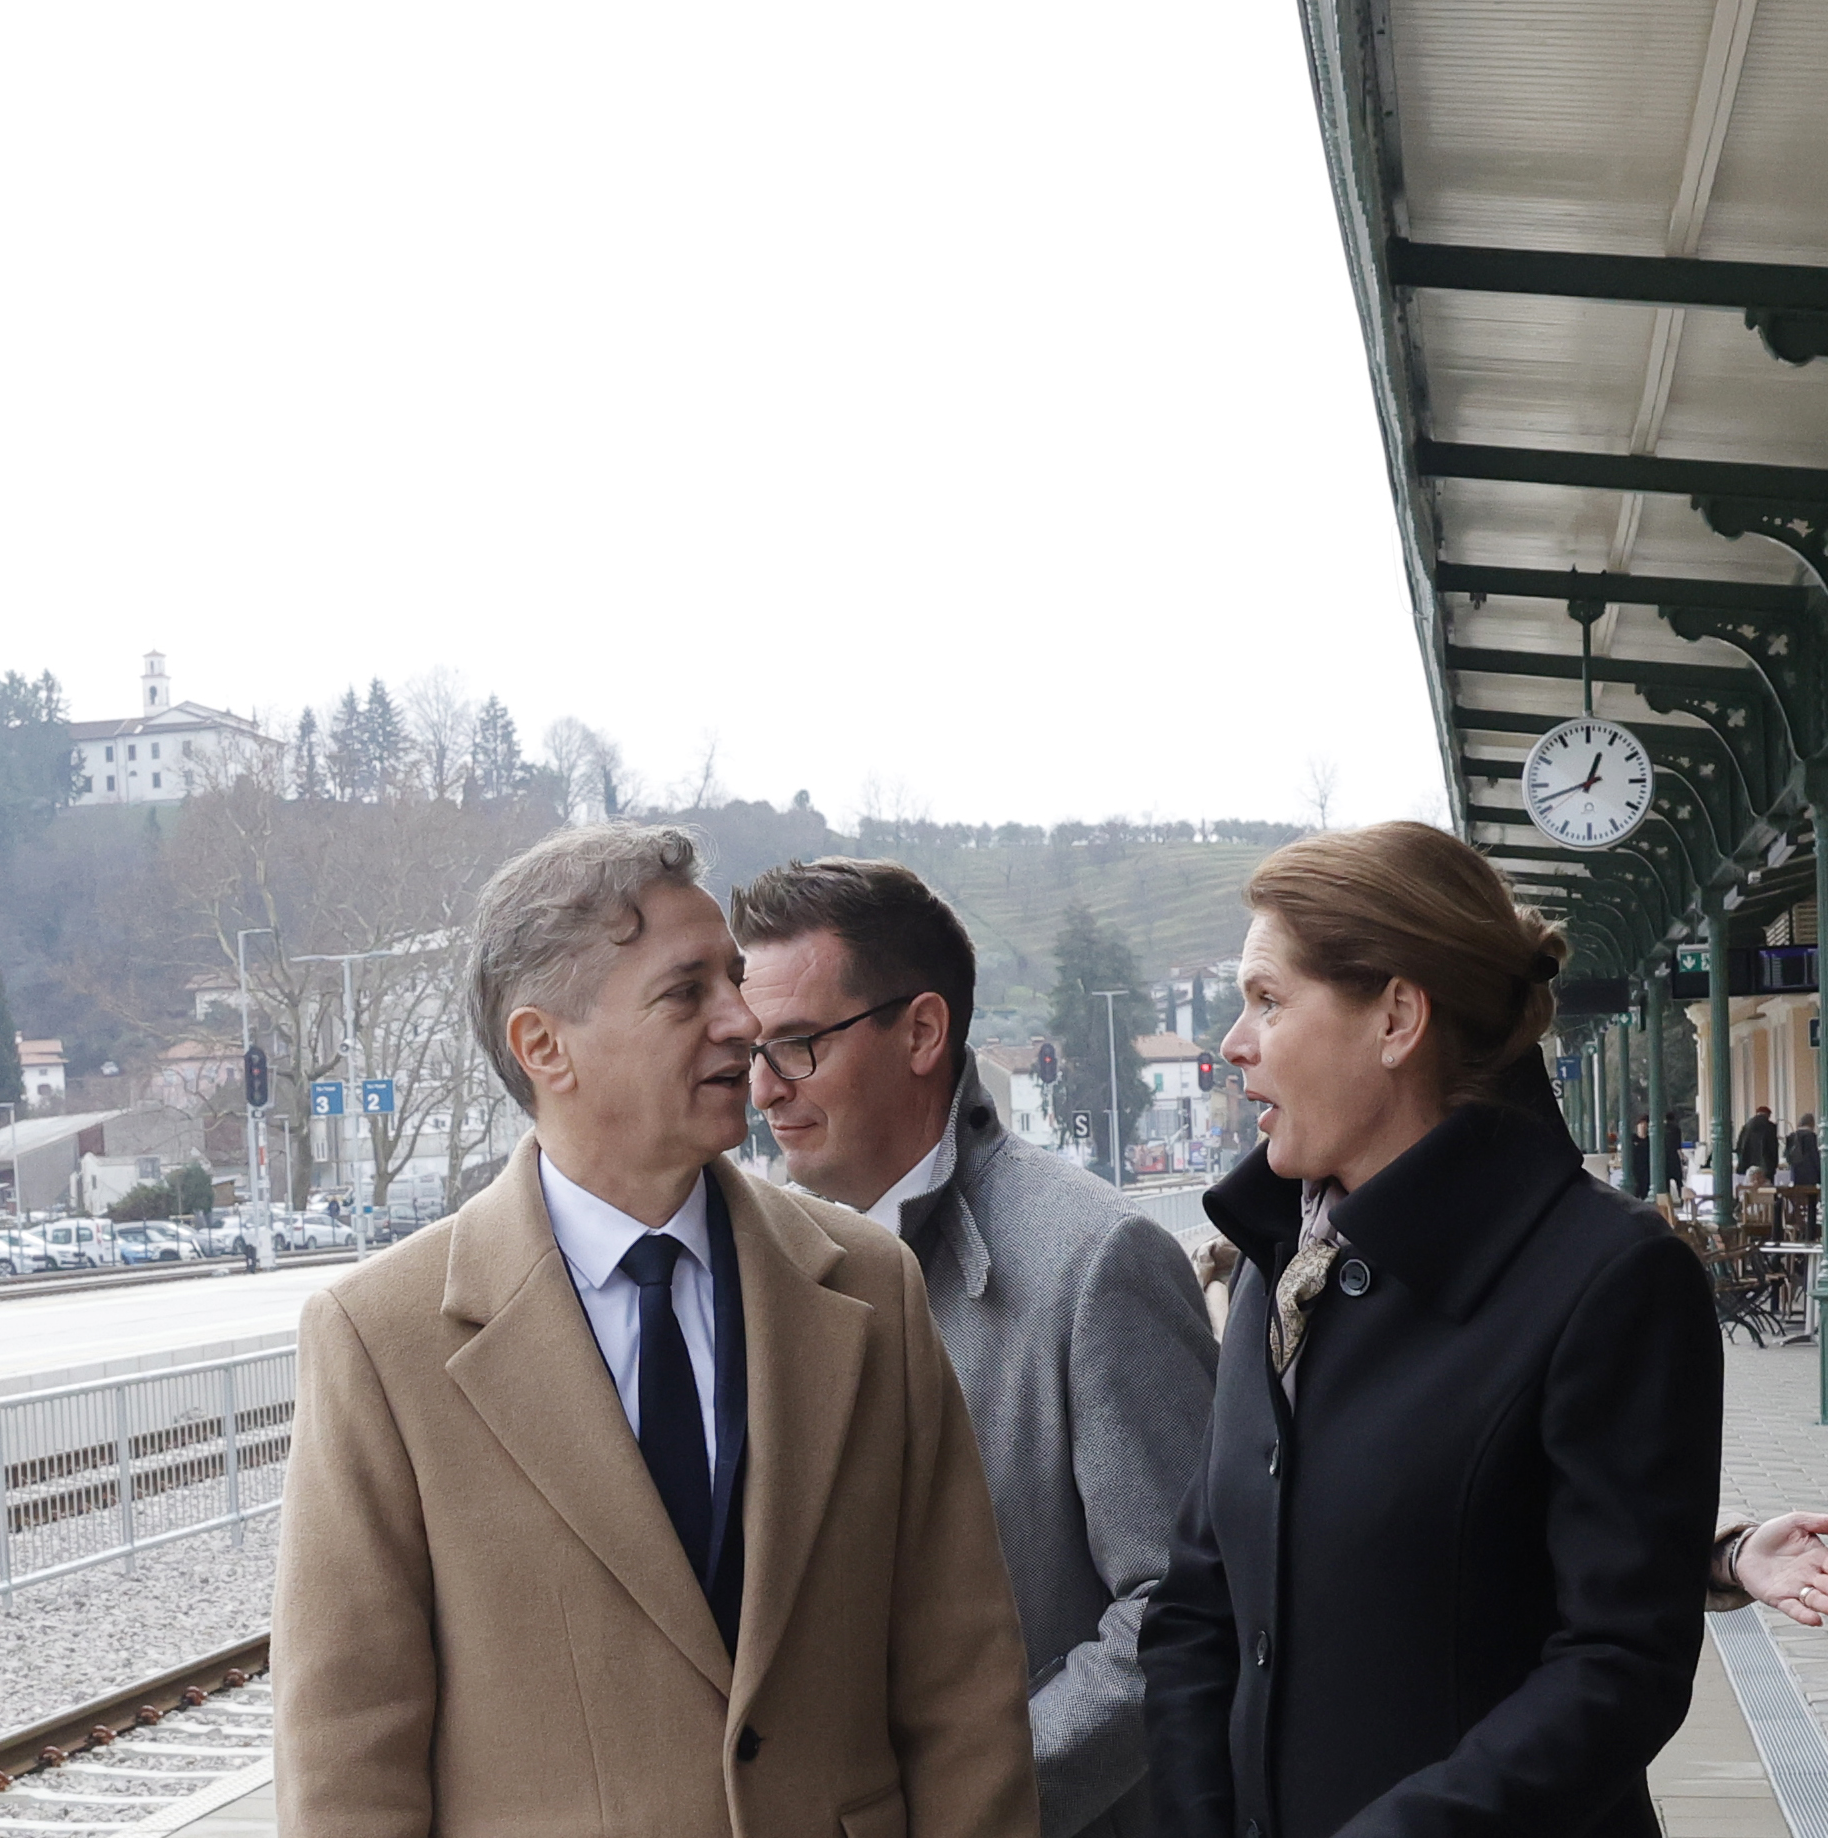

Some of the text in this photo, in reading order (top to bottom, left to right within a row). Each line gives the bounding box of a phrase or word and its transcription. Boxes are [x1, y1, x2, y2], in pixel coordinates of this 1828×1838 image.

[1559, 1066, 1567, 1079] 1
[1551, 1079, 1563, 1098] S
[315, 1095, 330, 1114] 3
[367, 1093, 381, 1111] 2
[1075, 1114, 1088, 1137] S
